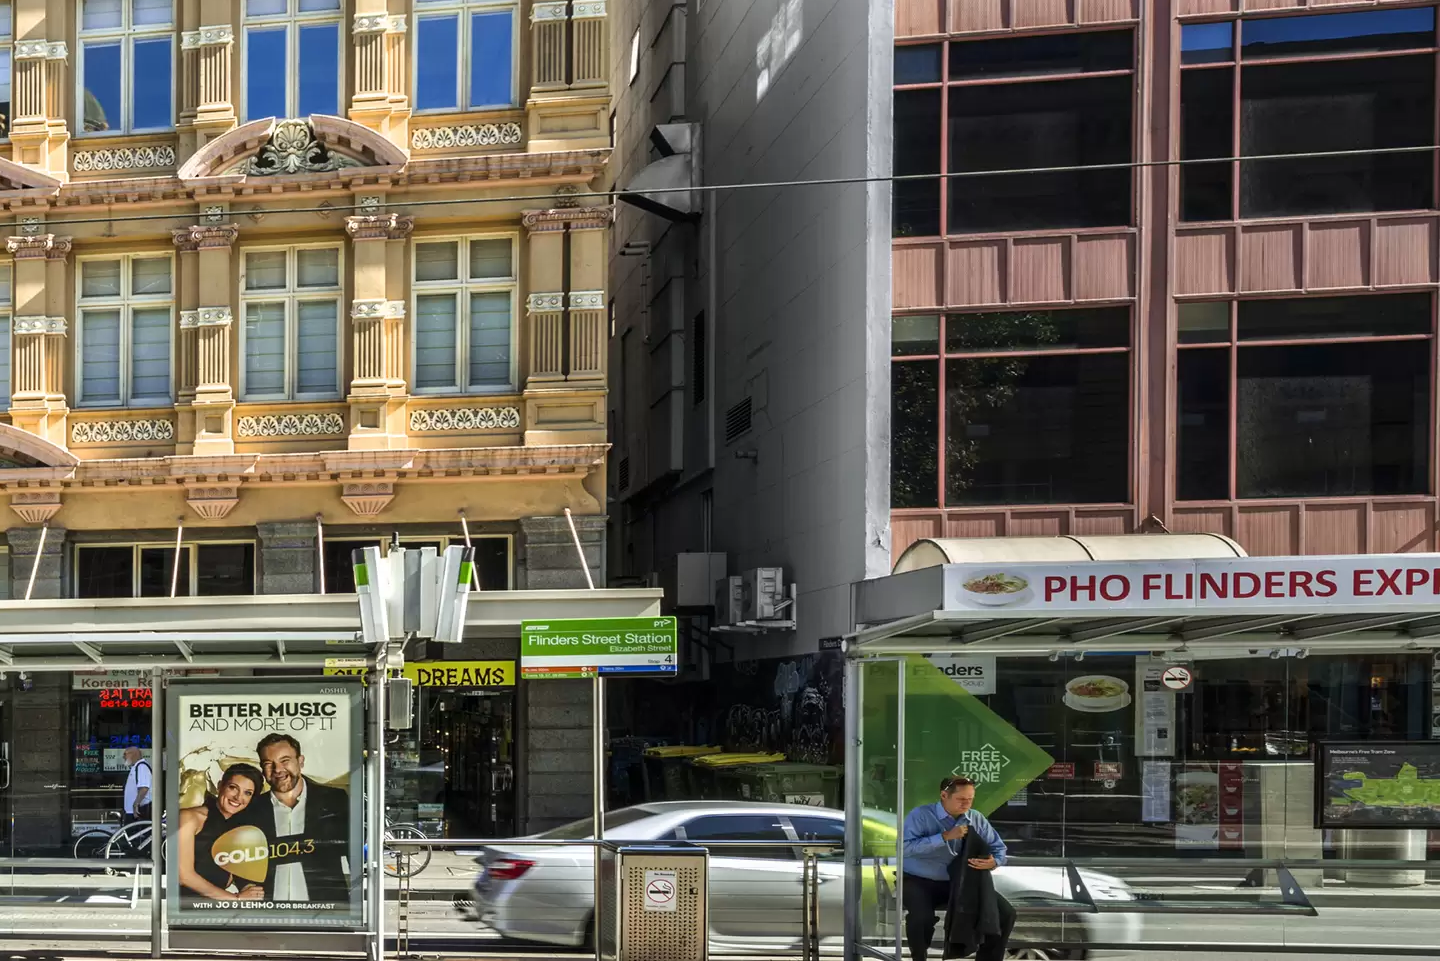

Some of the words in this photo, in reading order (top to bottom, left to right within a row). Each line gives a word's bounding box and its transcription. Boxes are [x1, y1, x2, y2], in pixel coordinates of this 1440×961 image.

[1044, 575, 1131, 602] PHO
[1143, 570, 1338, 600] FLINDERS
[1353, 568, 1440, 596] EXP
[528, 635, 579, 646] Flinders
[582, 634, 621, 645] Street
[625, 633, 671, 644] Station
[664, 655, 672, 663] 4
[417, 668, 504, 685] DREAMS
[81, 679, 129, 688] Korean
[962, 680, 984, 688] Soup
[128, 689, 152, 699] TRA
[131, 700, 152, 708] 808
[190, 703, 263, 718] BETTER
[268, 702, 337, 717] MUSIC
[189, 718, 229, 731] AND
[234, 718, 285, 731] MORE
[290, 717, 315, 731] OF
[320, 717, 337, 731] IT
[961, 751, 1000, 762] FREE
[961, 762, 1000, 772] TRAM
[961, 772, 1000, 782] ZONE
[215, 901, 230, 909] JO
[240, 901, 274, 909] LEHMO
